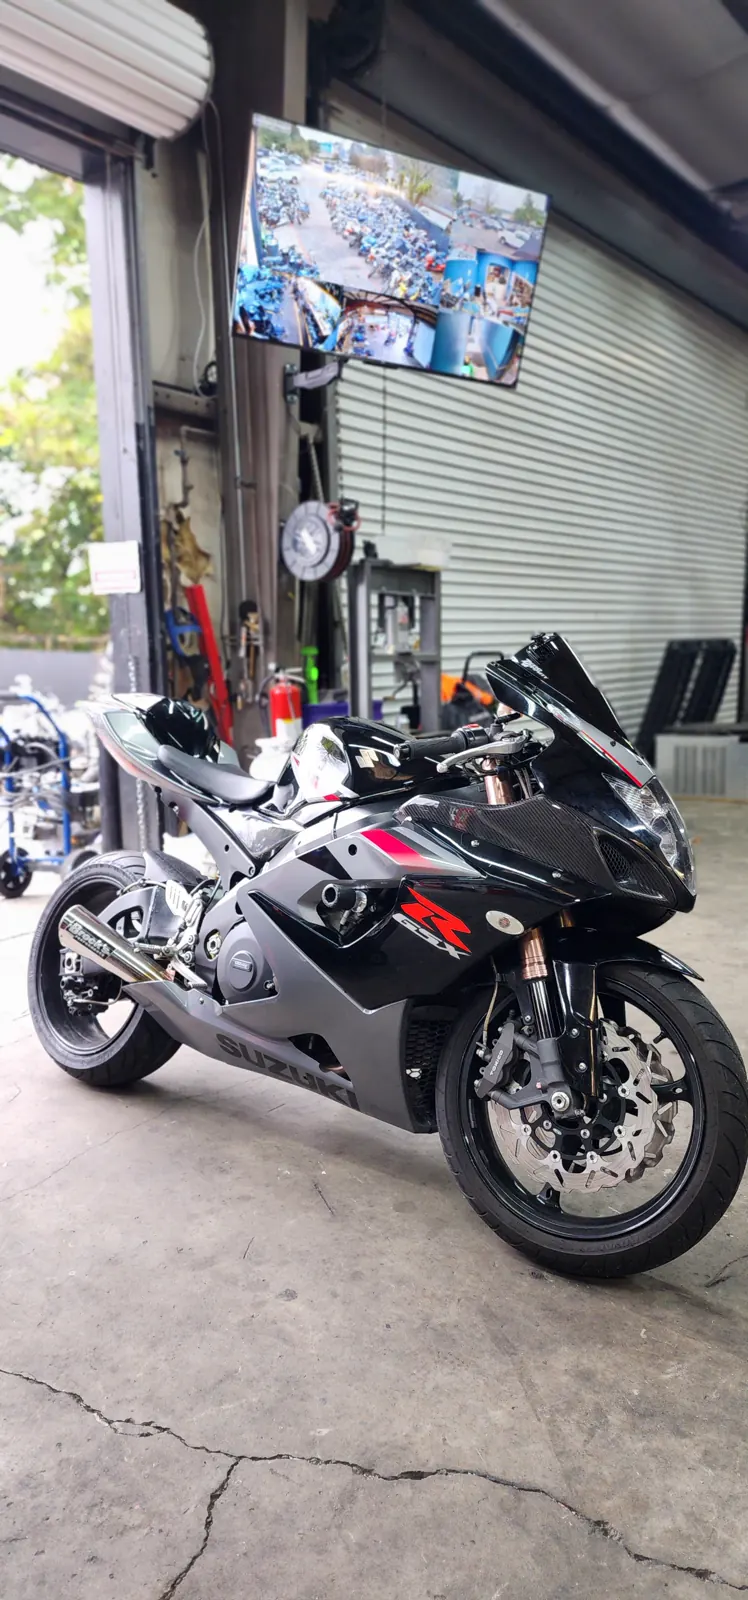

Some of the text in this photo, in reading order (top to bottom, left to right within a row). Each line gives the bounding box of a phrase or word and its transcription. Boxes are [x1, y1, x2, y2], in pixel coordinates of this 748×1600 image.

[68, 921, 110, 956] Brock's
[392, 913, 471, 960] GSX
[401, 886, 472, 953] R
[216, 1033, 360, 1112] SUZUKI
